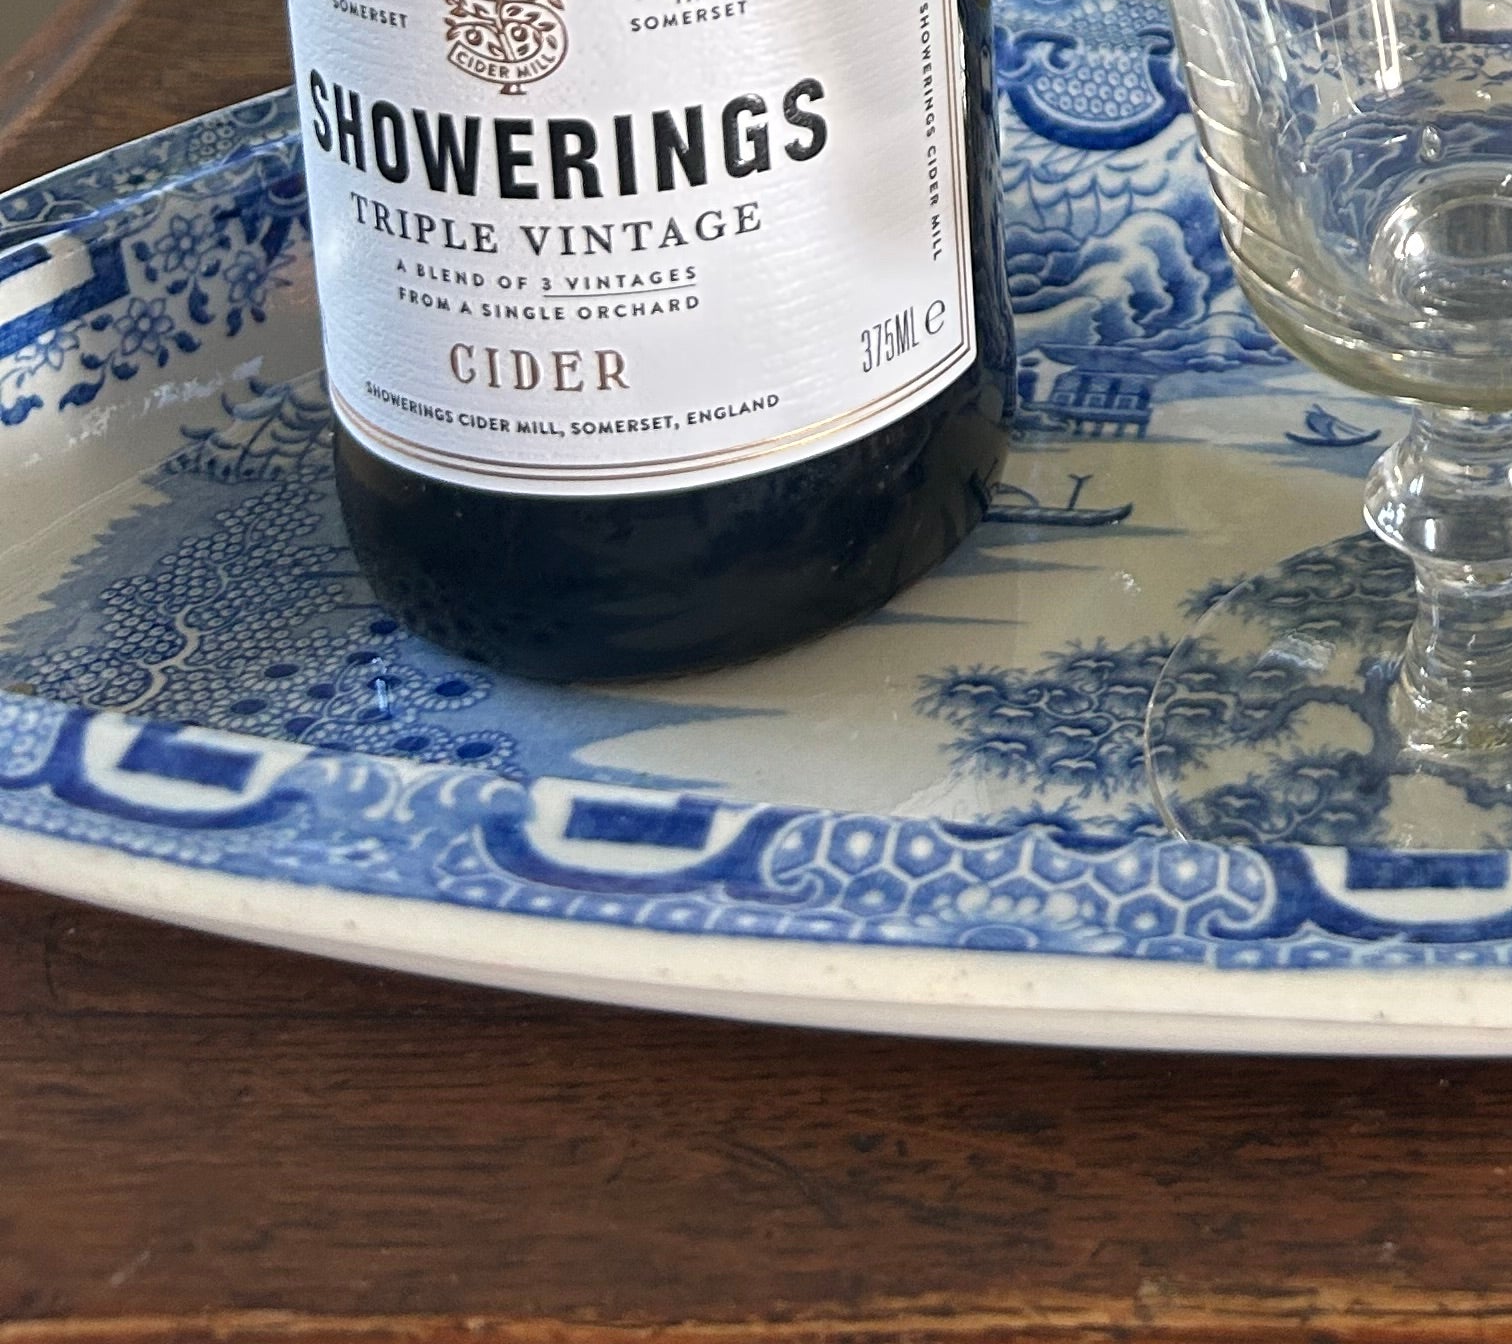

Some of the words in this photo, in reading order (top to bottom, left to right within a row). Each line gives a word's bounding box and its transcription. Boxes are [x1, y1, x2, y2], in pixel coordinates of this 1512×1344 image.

[630, 0, 747, 32] SOMERSET
[456, 50, 511, 79] CIDER
[517, 53, 556, 78] MILL
[919, 2, 936, 138] SHOWERINGS
[309, 68, 830, 200] SHOWERINGS
[926, 145, 939, 207] CIDER
[350, 191, 499, 254] TRIPLE
[519, 201, 762, 257] VINTAGE
[931, 214, 943, 262] MILL
[396, 258, 407, 273] A
[416, 263, 484, 287] BLEND
[497, 276, 528, 291] OF
[542, 276, 552, 291] 3
[565, 266, 697, 291] VINTAGES
[397, 286, 451, 311] FROM
[460, 301, 473, 315] A
[482, 303, 565, 321] SINGLE
[577, 295, 700, 321] ORCHARD
[861, 305, 920, 373] 375ML
[449, 342, 632, 393] CIDER
[366, 381, 454, 423] SHOWERINGS
[458, 413, 511, 433] CIDER
[516, 419, 565, 438] MILL,
[571, 415, 680, 436] SOMERSET,
[687, 394, 780, 425] ENGLAND
